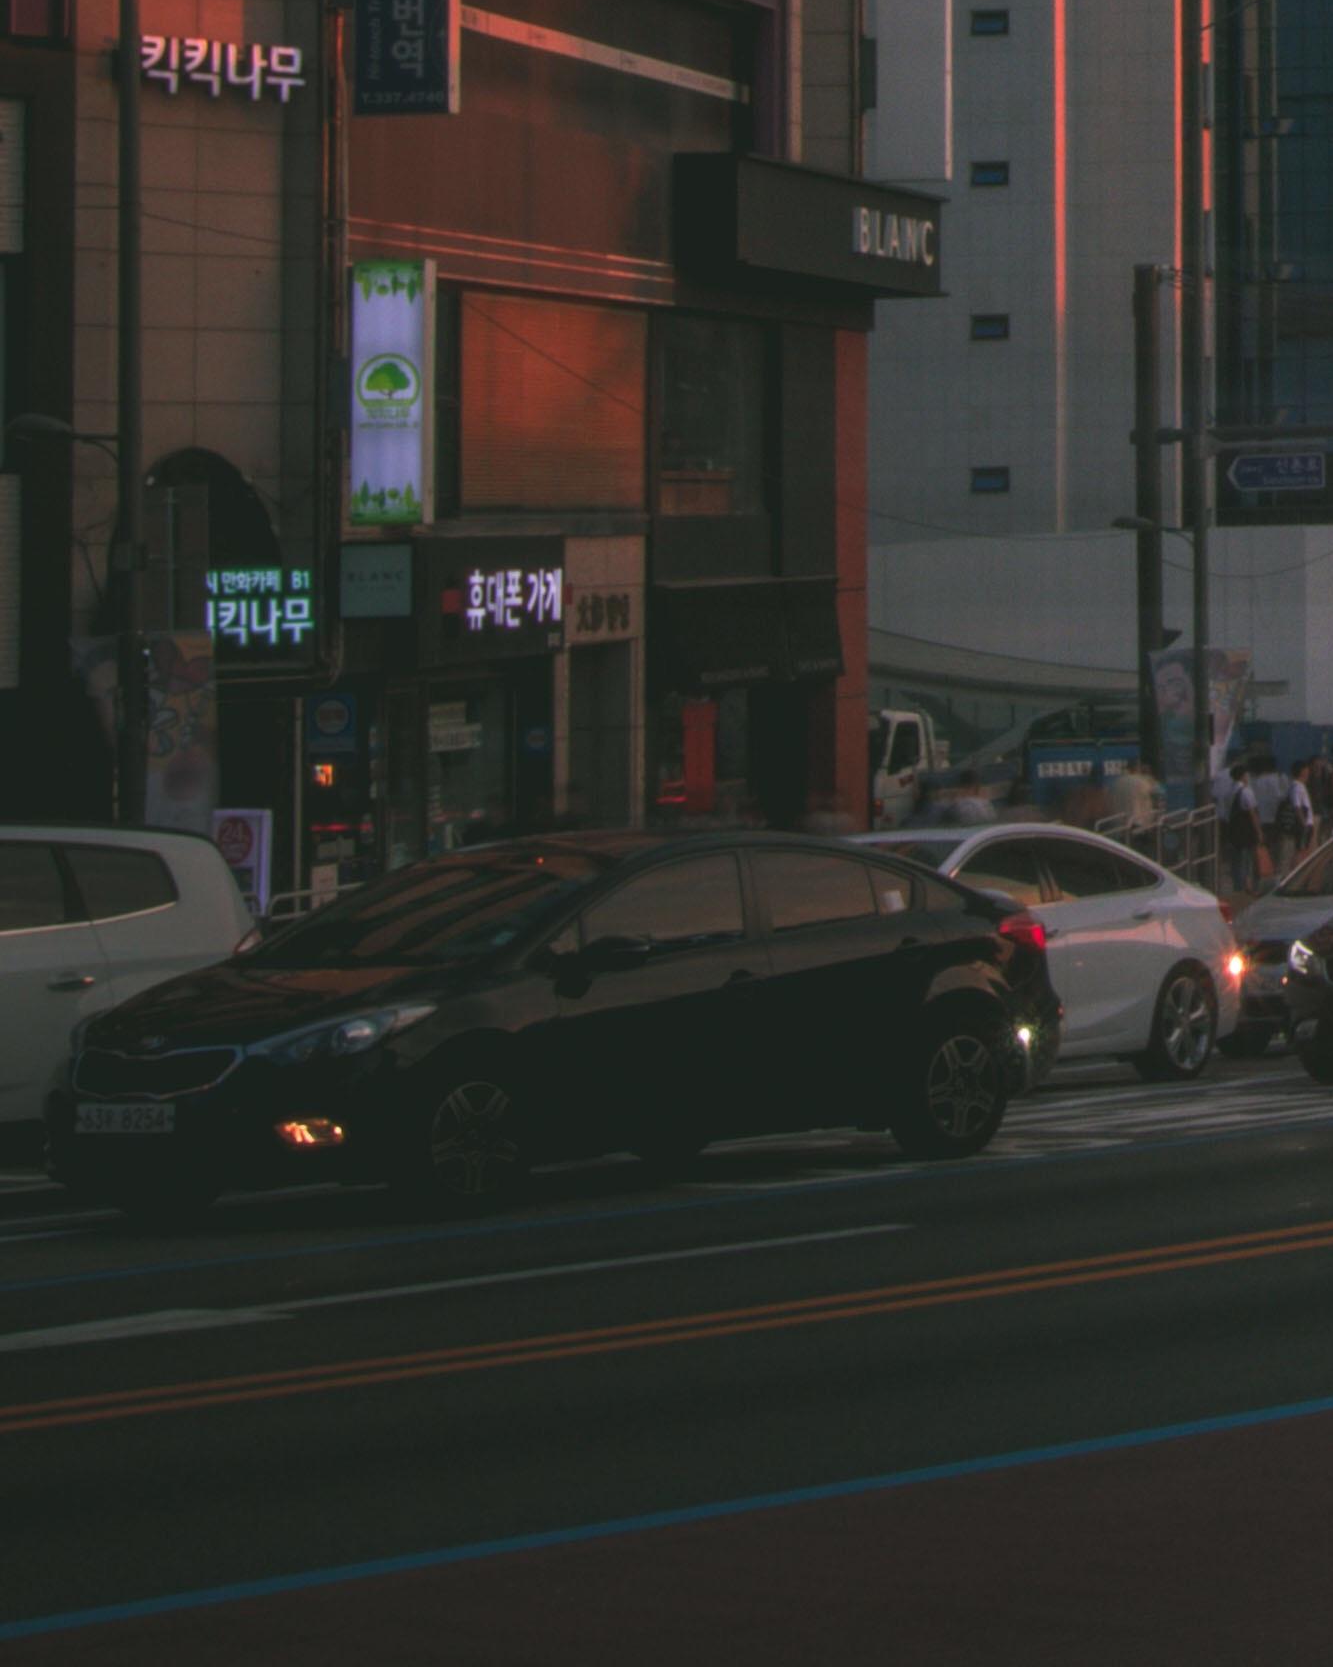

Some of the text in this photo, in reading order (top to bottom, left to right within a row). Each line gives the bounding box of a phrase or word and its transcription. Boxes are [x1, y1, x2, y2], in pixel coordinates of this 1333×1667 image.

[141, 34, 307, 103] 킥킥나무
[852, 206, 935, 267] BLANC
[221, 570, 282, 594] 만화카페
[290, 570, 310, 590] B1
[466, 568, 523, 630] 휴대폰
[527, 567, 563, 623] 가게
